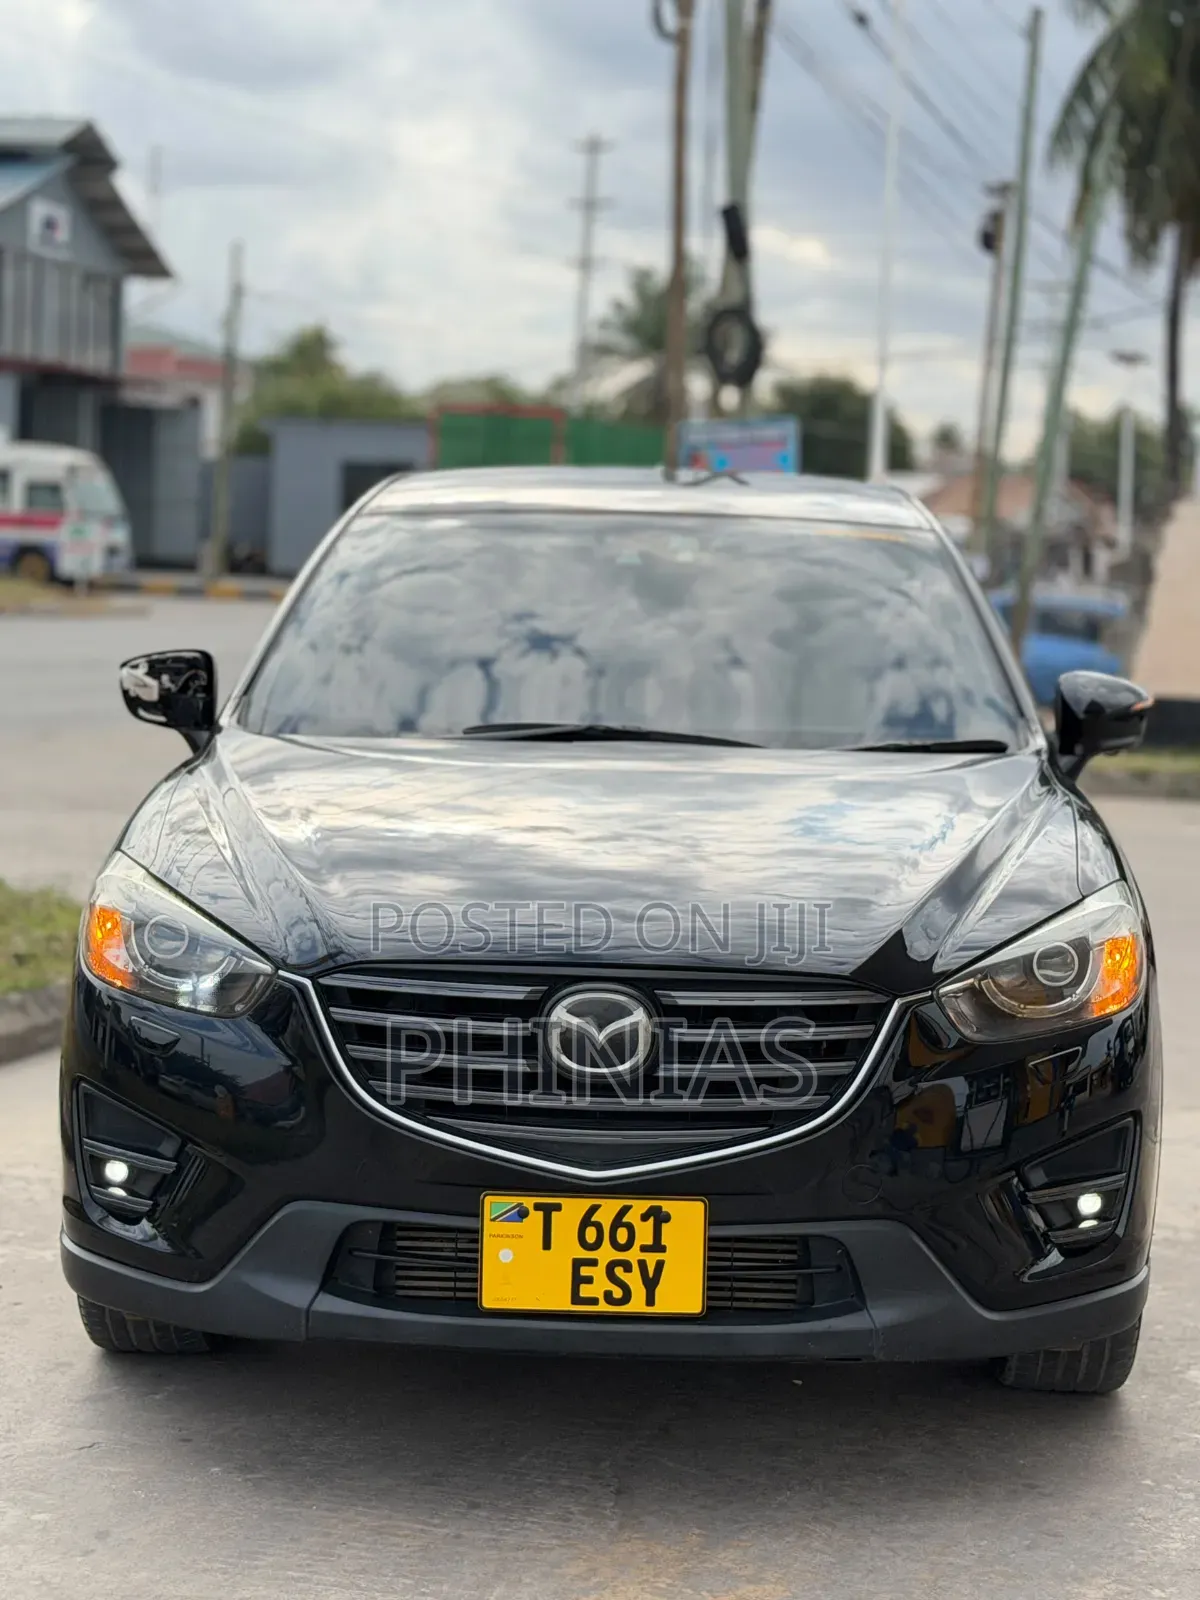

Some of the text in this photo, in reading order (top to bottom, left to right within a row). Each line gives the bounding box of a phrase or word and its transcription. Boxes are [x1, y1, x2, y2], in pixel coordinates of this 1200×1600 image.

[533, 1202, 668, 1253] T 661
[570, 1257, 666, 1307] ESY
